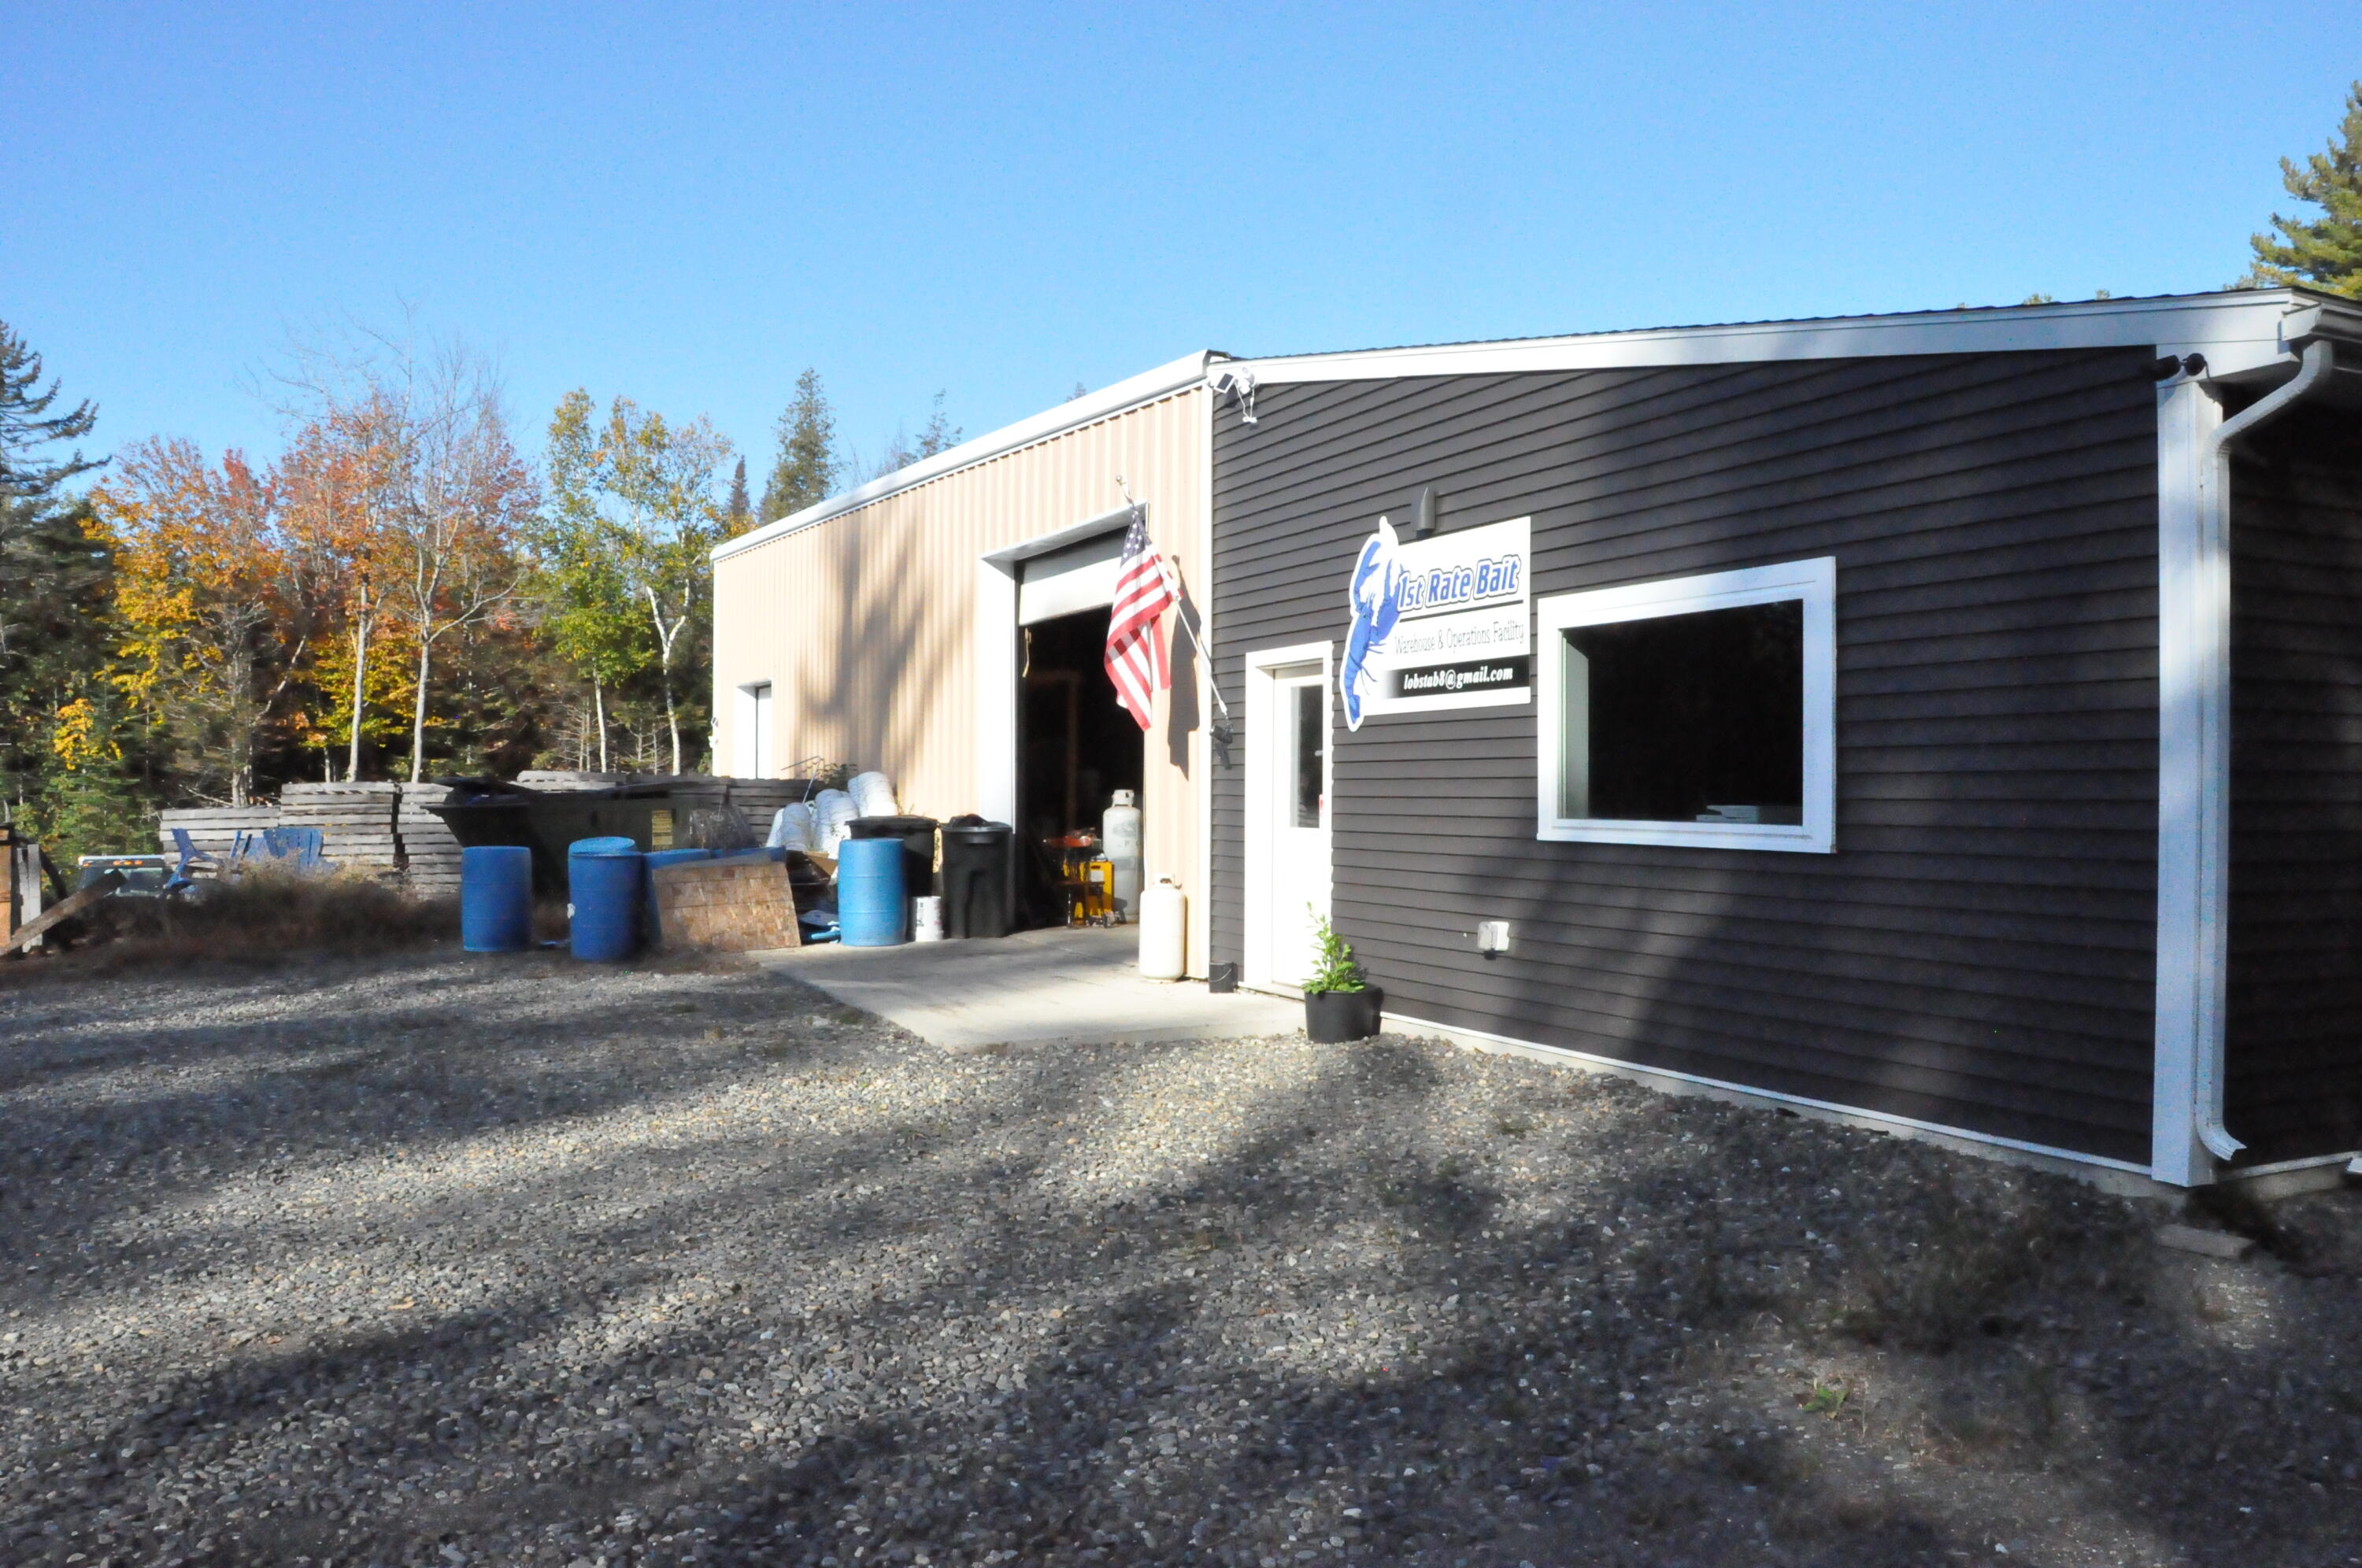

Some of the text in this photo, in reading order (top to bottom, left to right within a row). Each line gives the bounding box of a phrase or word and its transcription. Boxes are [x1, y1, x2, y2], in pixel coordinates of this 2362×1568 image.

[1398, 559, 1519, 608] 1st Rate Bait
[1394, 619, 1524, 654] Warehouse & Operations Facility
[1404, 666, 1513, 690] lobstab8@gmail.com
